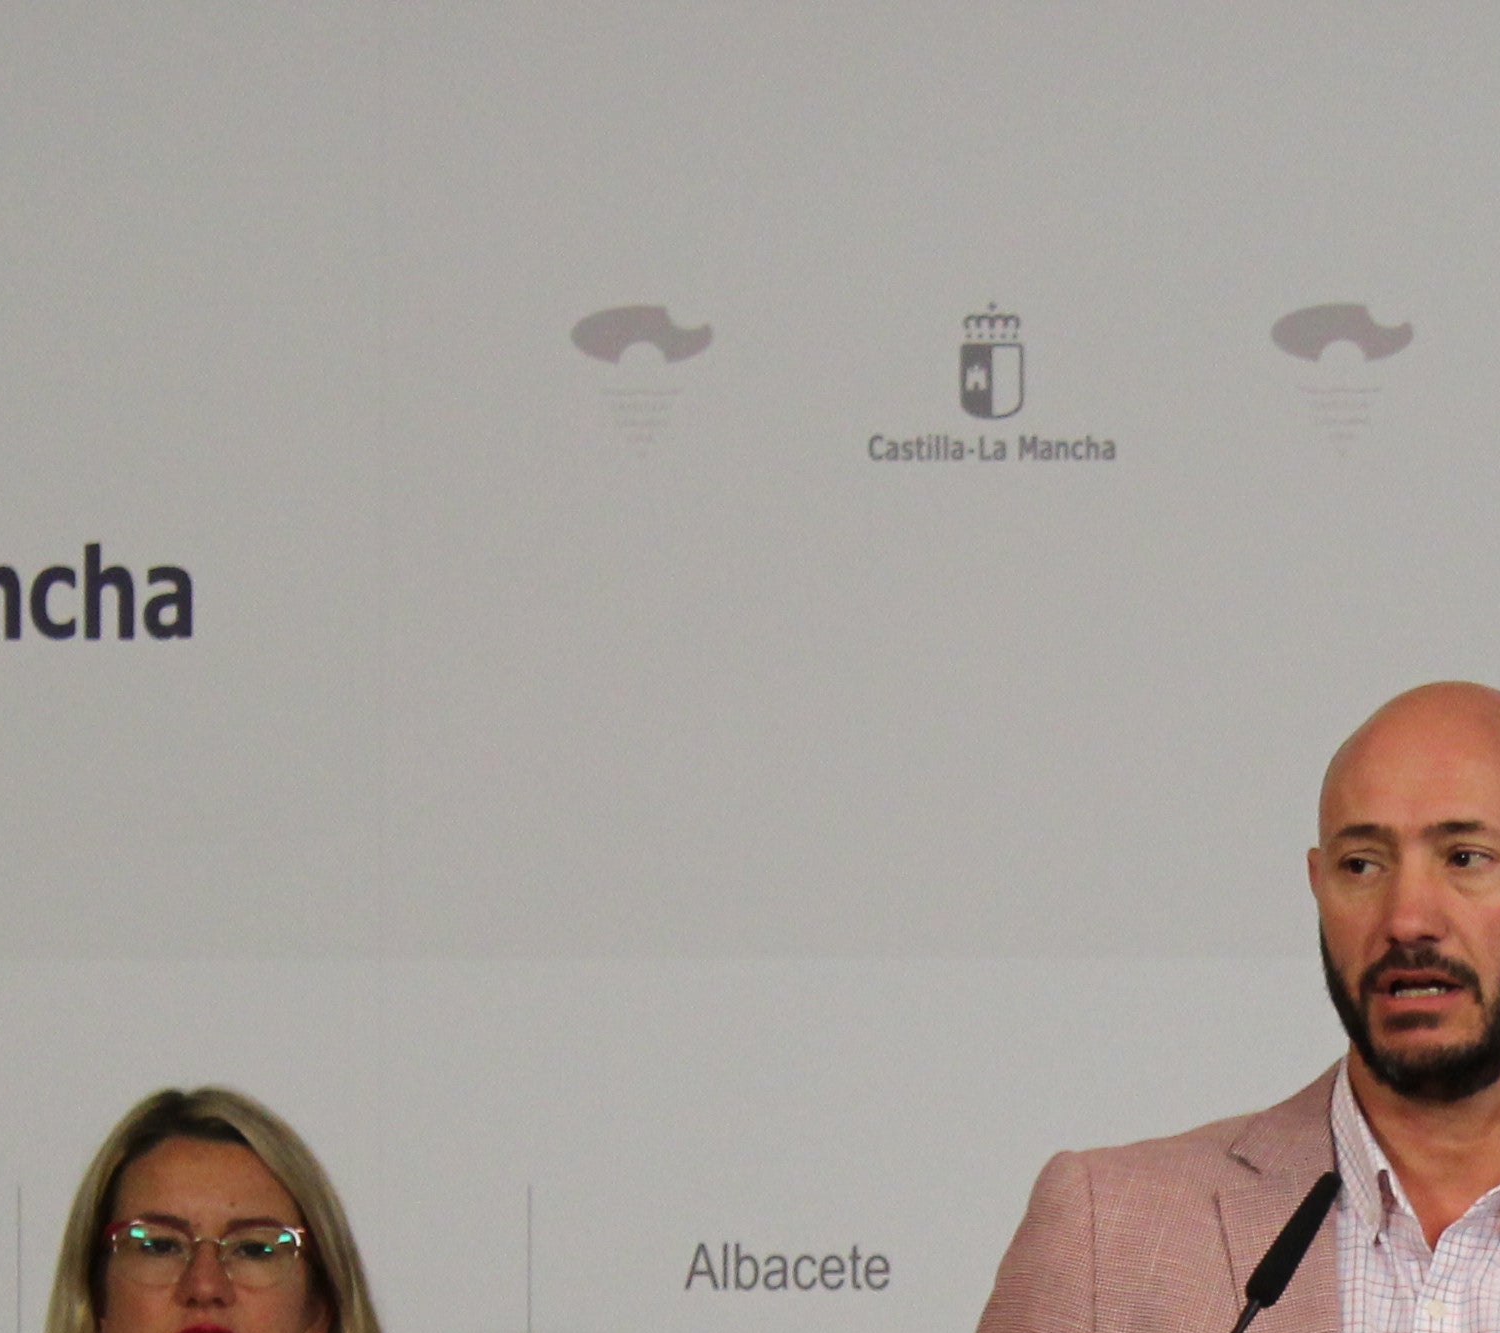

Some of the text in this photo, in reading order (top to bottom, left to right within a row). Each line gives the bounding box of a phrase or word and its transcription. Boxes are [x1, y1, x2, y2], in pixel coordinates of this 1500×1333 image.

[867, 433, 1117, 462] Castilla-La Mancha
[684, 1242, 891, 1292] Albacete
